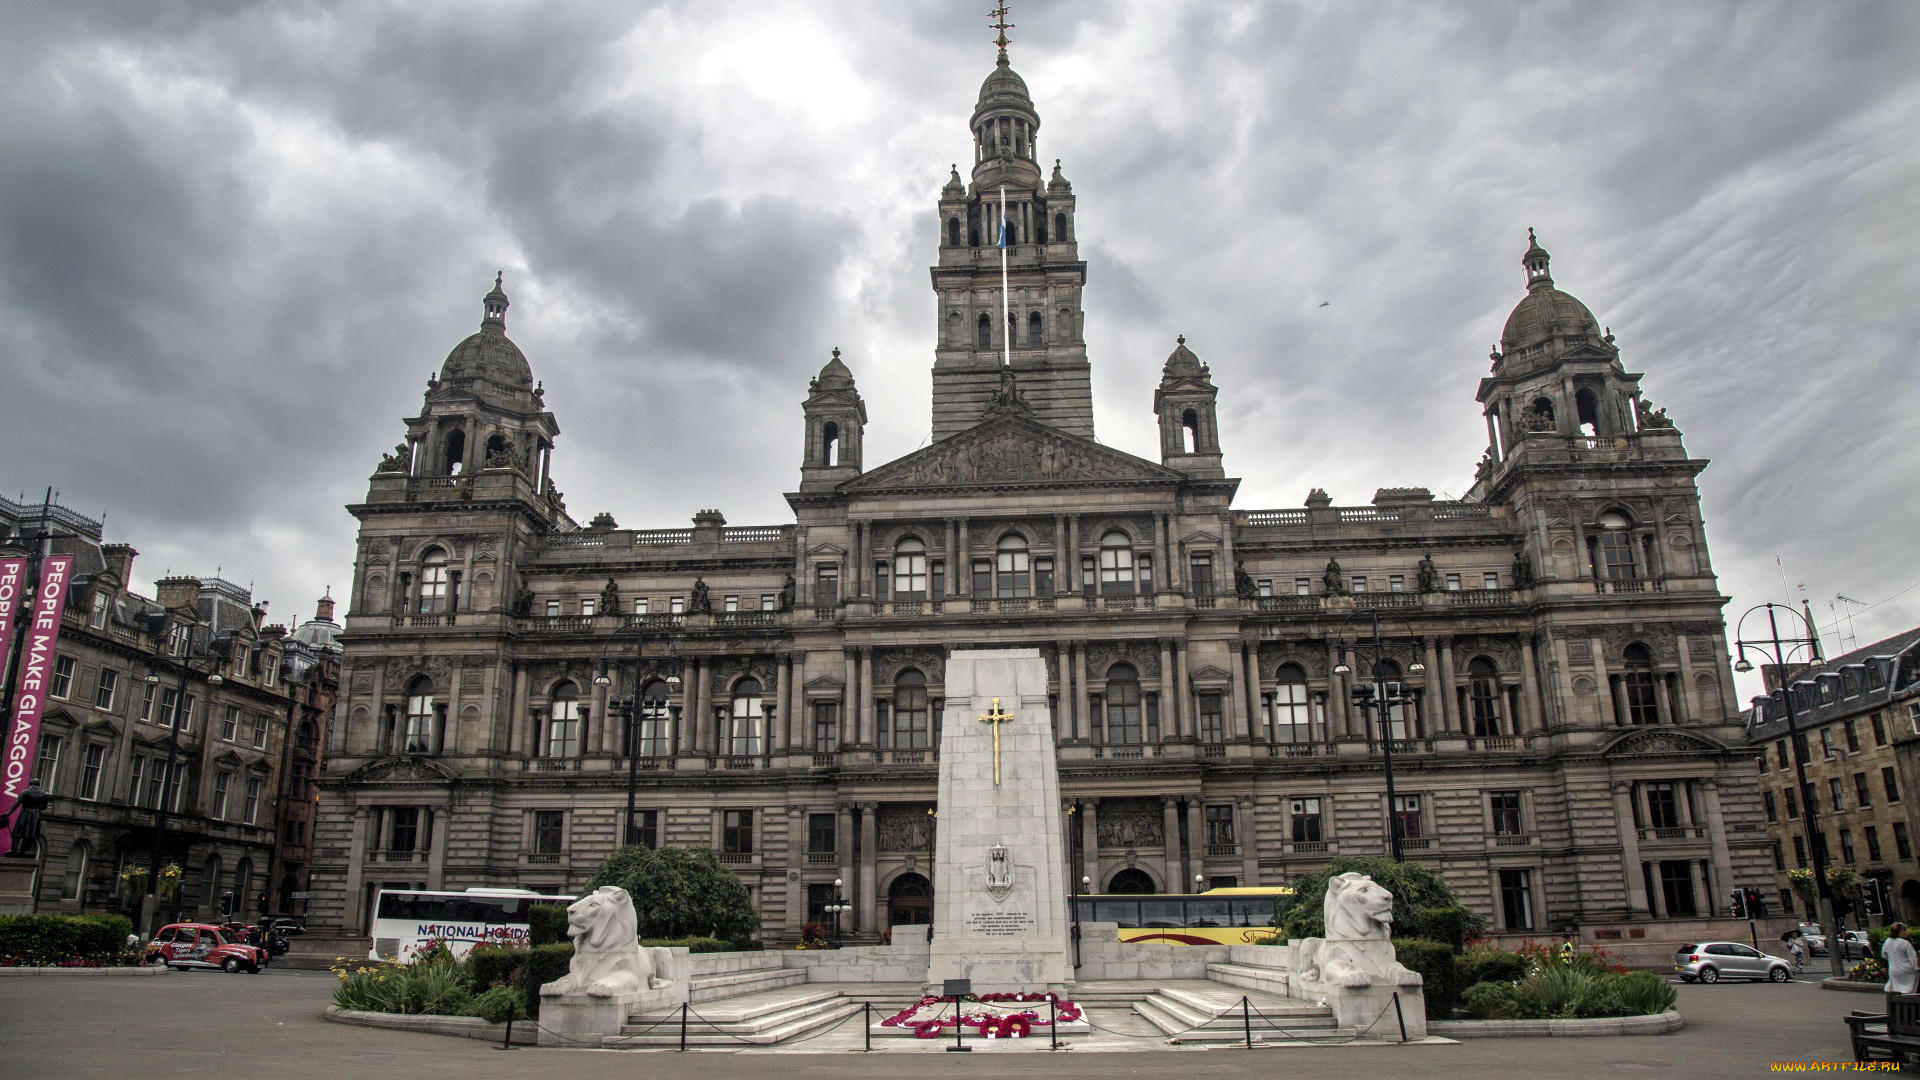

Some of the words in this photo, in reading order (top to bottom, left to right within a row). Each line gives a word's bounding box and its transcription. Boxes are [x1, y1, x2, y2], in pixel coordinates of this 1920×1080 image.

[36, 561, 66, 629] PEOPLE
[23, 635, 50, 690] MAKE
[4, 694, 37, 798] GLASGOW
[417, 924, 482, 938] NATIONAL
